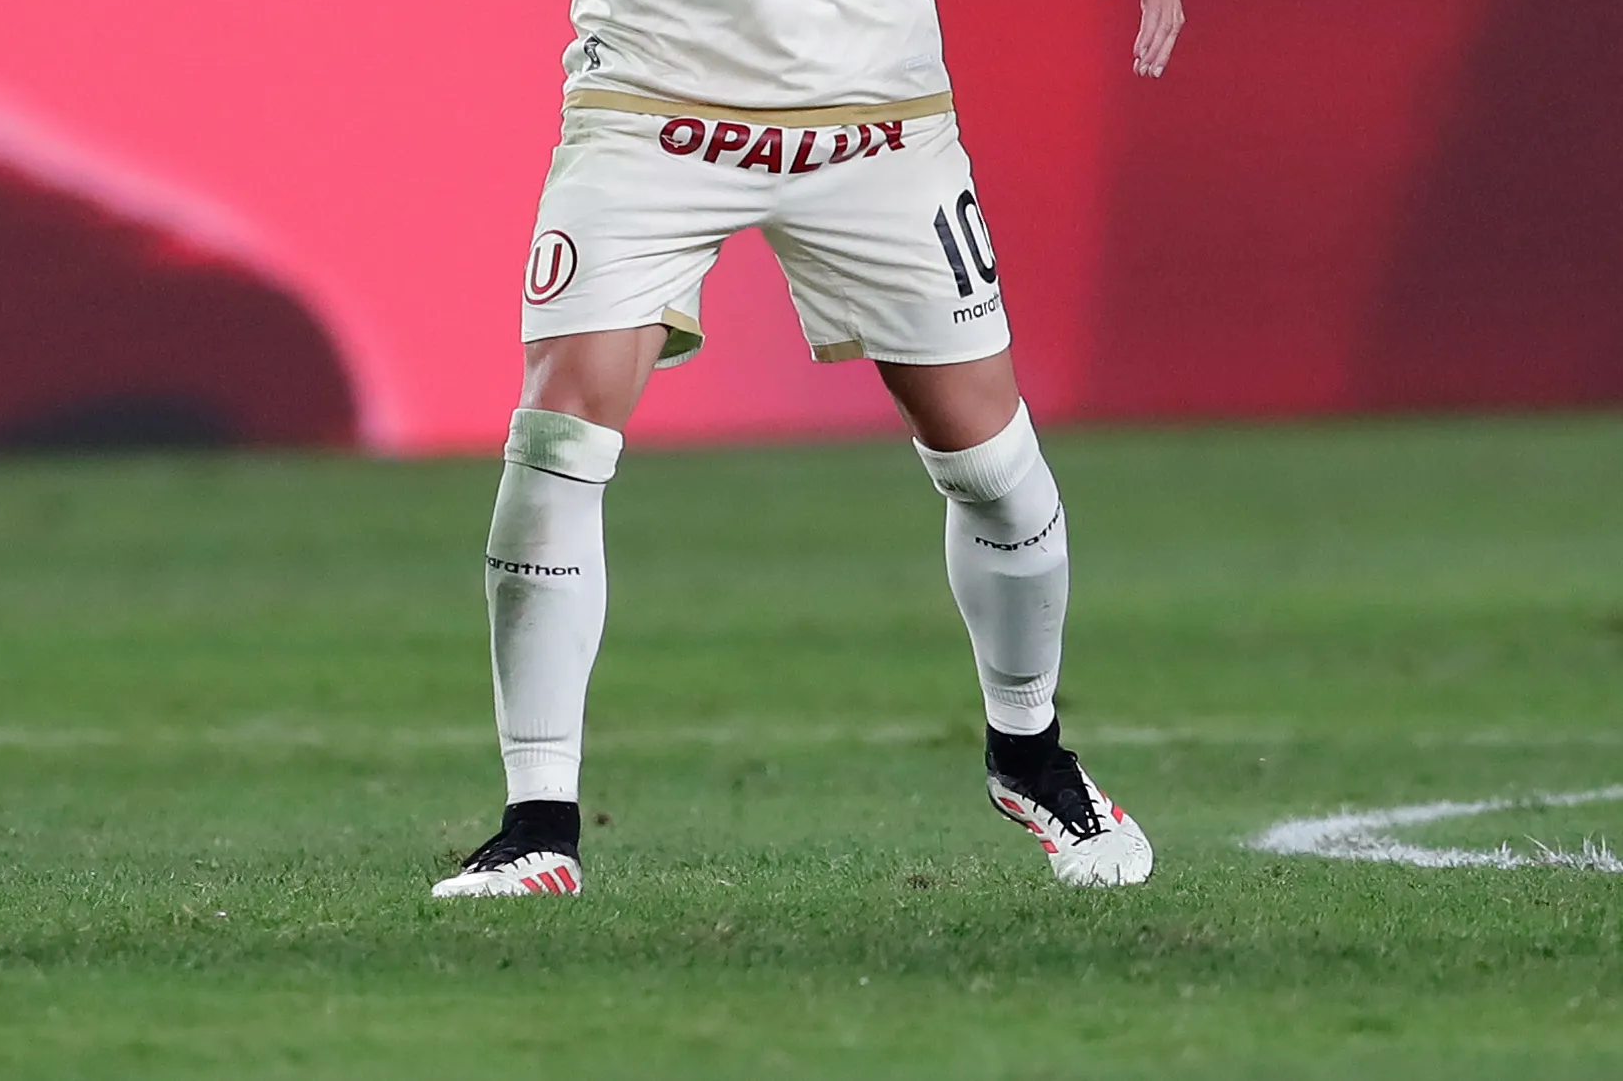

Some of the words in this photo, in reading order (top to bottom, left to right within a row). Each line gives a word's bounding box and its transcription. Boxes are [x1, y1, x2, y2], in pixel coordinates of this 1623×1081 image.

[530, 243, 564, 295] U
[933, 189, 998, 299] 10
[484, 554, 581, 576] arathon
